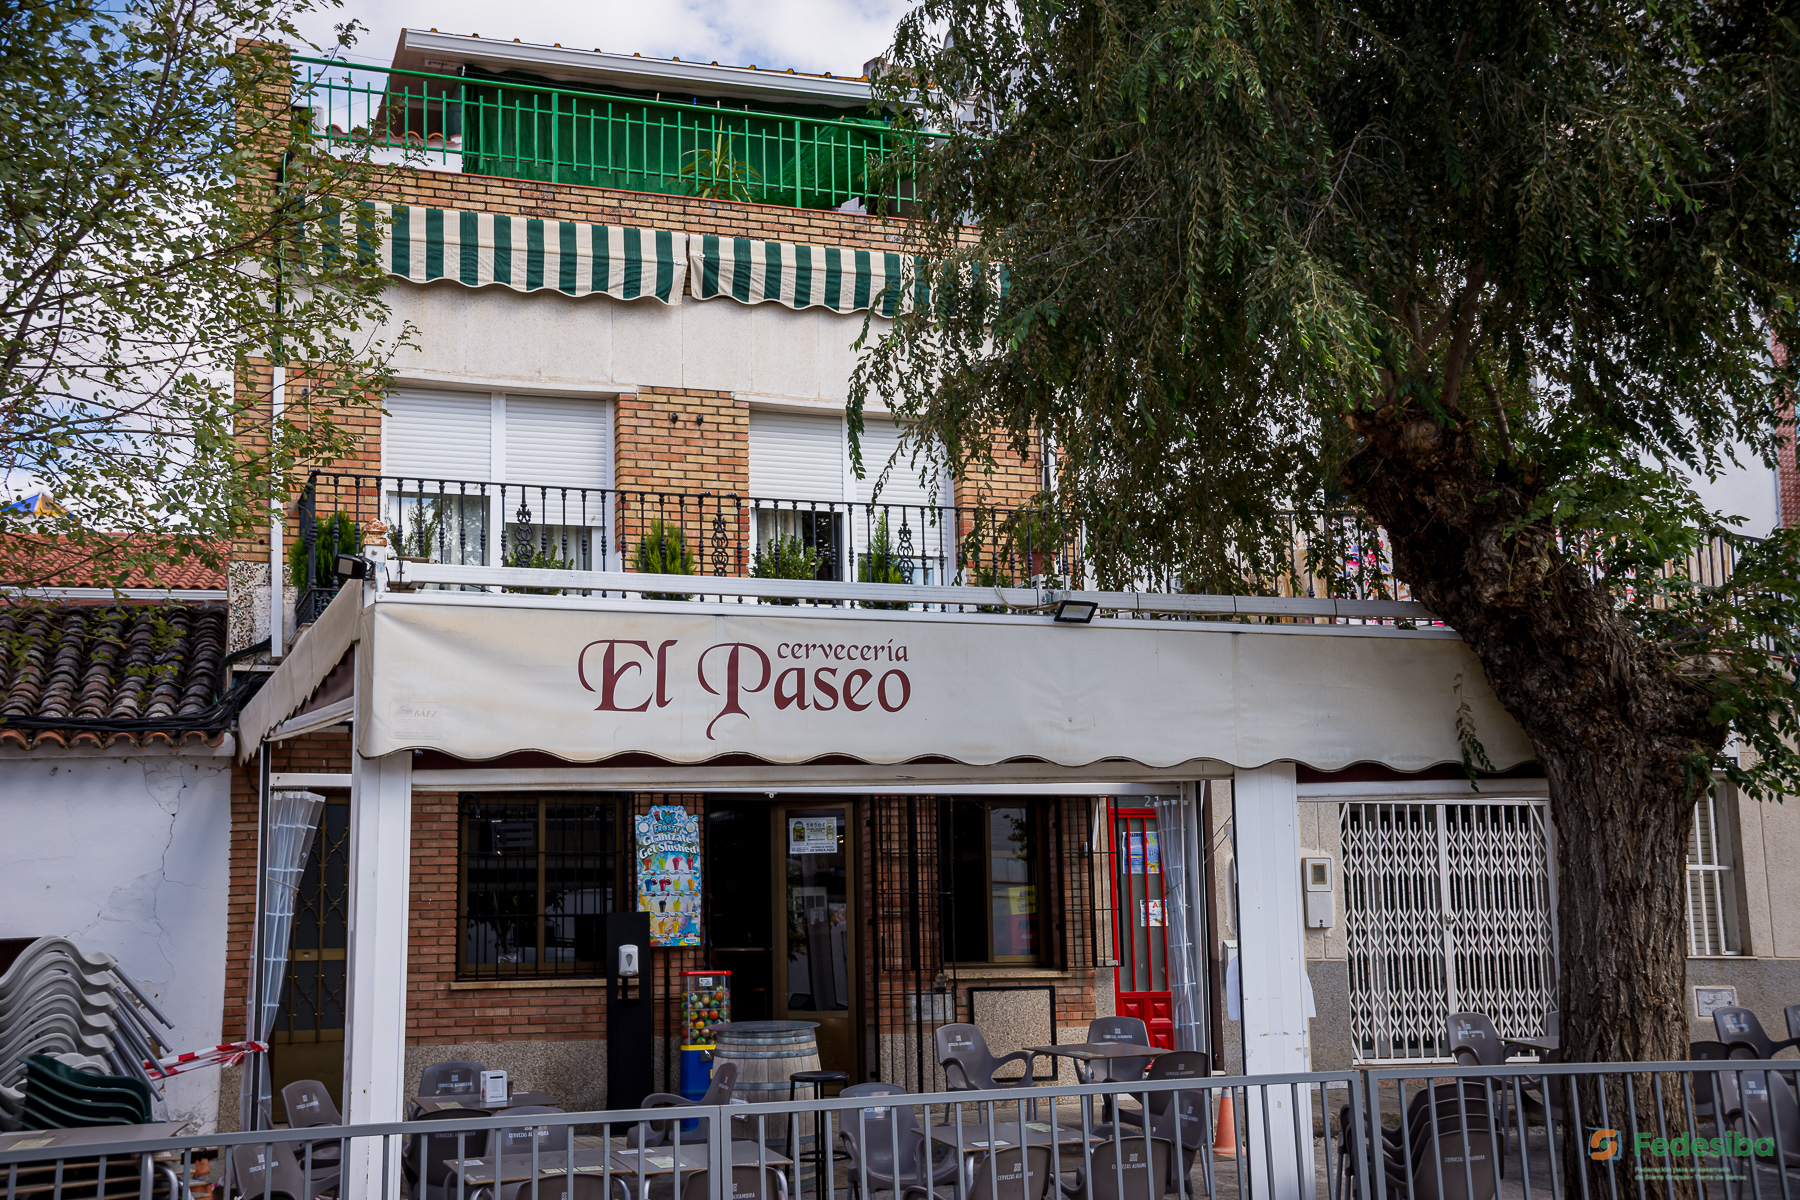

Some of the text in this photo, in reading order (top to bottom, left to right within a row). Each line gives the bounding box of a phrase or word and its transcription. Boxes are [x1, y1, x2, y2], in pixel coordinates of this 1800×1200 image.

[777, 638, 910, 662] cervecería
[577, 638, 911, 741] El Paseo
[652, 823, 682, 834] FROSTY
[639, 844, 658, 860] Get
